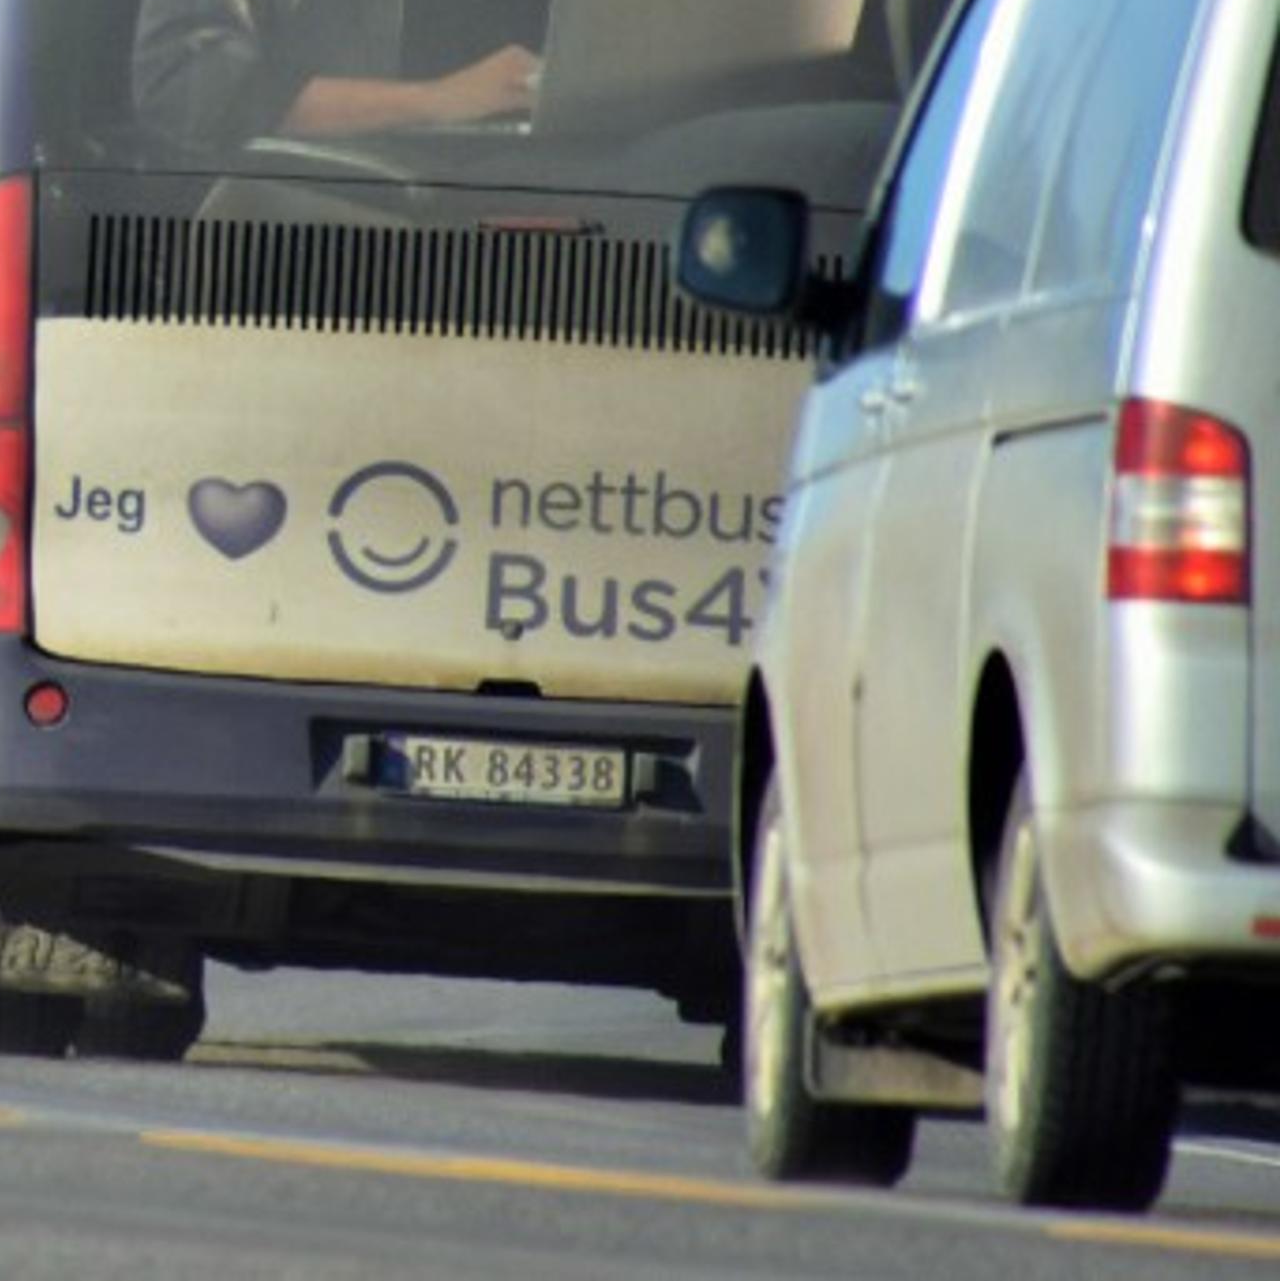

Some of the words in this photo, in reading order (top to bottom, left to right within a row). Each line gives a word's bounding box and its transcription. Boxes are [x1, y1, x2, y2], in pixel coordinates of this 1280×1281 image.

[54, 473, 145, 533] Jeg
[485, 551, 772, 646] Bus4
[416, 744, 465, 784] RK
[488, 749, 614, 791] 84338
